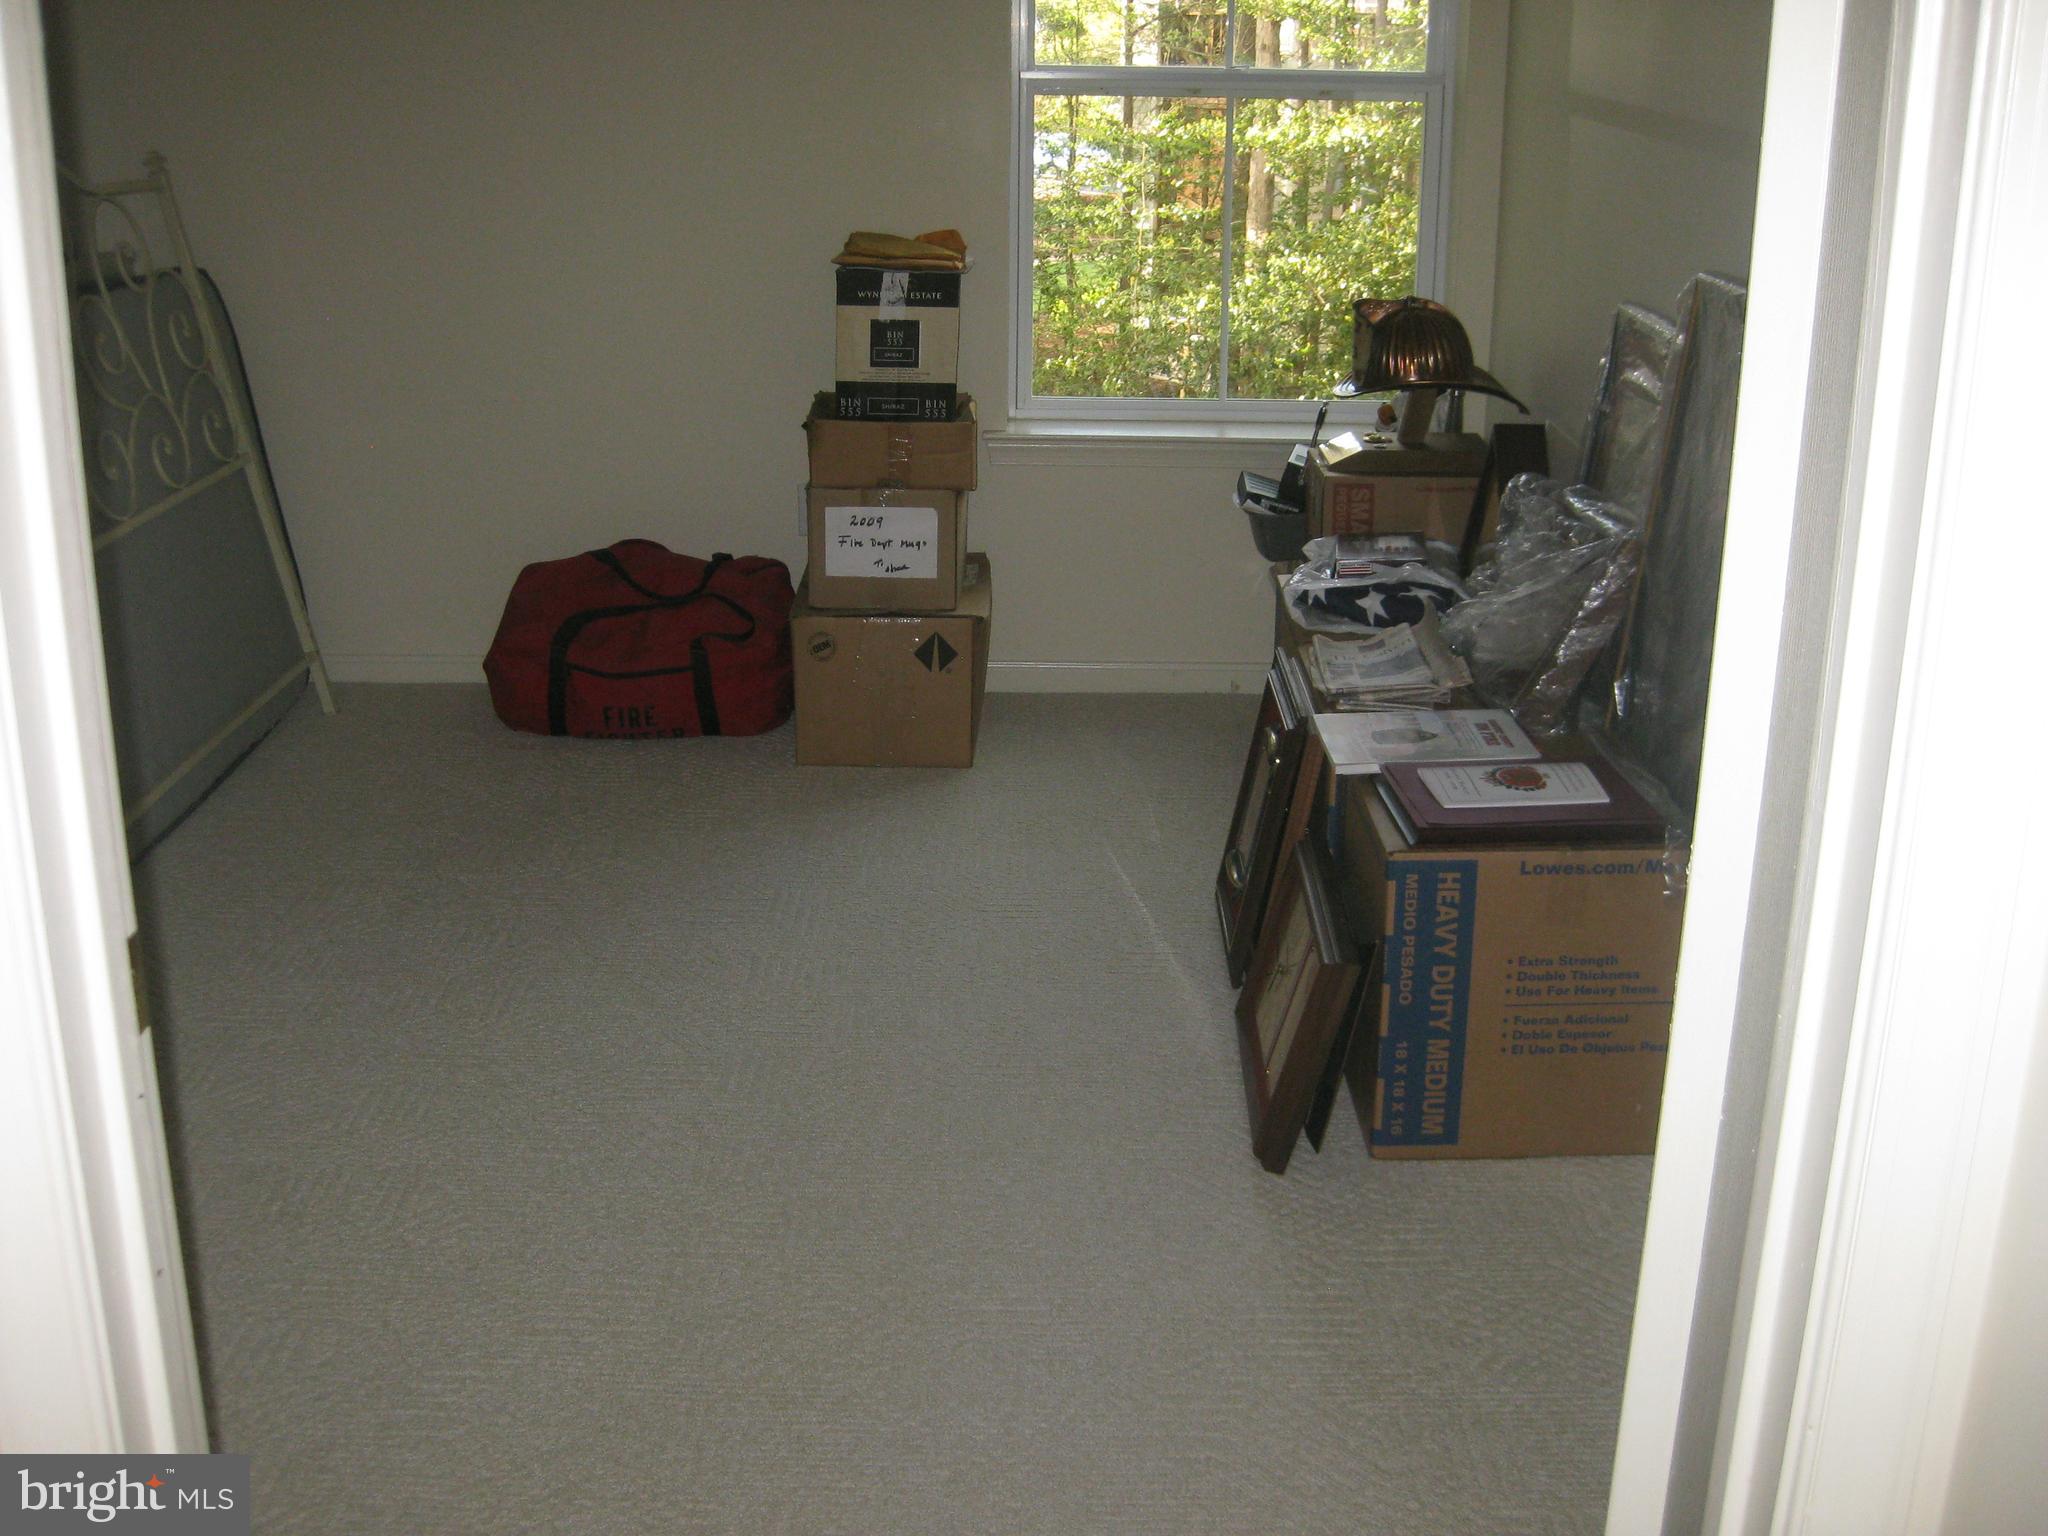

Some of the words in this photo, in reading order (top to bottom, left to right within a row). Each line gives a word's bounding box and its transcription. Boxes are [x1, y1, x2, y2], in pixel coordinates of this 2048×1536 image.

[910, 292, 942, 300] ESTATE
[887, 331, 904, 339] BIN
[840, 398, 862, 407] BIN
[925, 399, 946, 409] BIN
[849, 515, 884, 529] 2009
[602, 705, 658, 728] FIRE
[1402, 873, 1419, 930] MEDIO
[1433, 872, 1461, 959] HEAVY
[1518, 956, 1554, 967] Extra
[1558, 955, 1618, 968] Strength
[1398, 935, 1415, 1005] PESADO
[1517, 971, 1566, 982] Double
[1570, 970, 1640, 981] Thickness
[1428, 965, 1456, 1031] DUTY
[1516, 986, 1541, 997] Use
[1547, 986, 1570, 996] For
[1573, 985, 1617, 997] Heavy
[1513, 1015, 1560, 1026] Fuerza
[1565, 1014, 1629, 1025] Adicional
[1511, 1030, 1553, 1041] Doble
[1395, 1040, 1408, 1059] 18
[1510, 1044, 1524, 1055] El
[1528, 1044, 1554, 1055] Uso
[1558, 1043, 1578, 1054] De
[1582, 1042, 1636, 1056] Objetos
[1392, 1080, 1406, 1097] 18
[1421, 1039, 1451, 1135] MEDIUM
